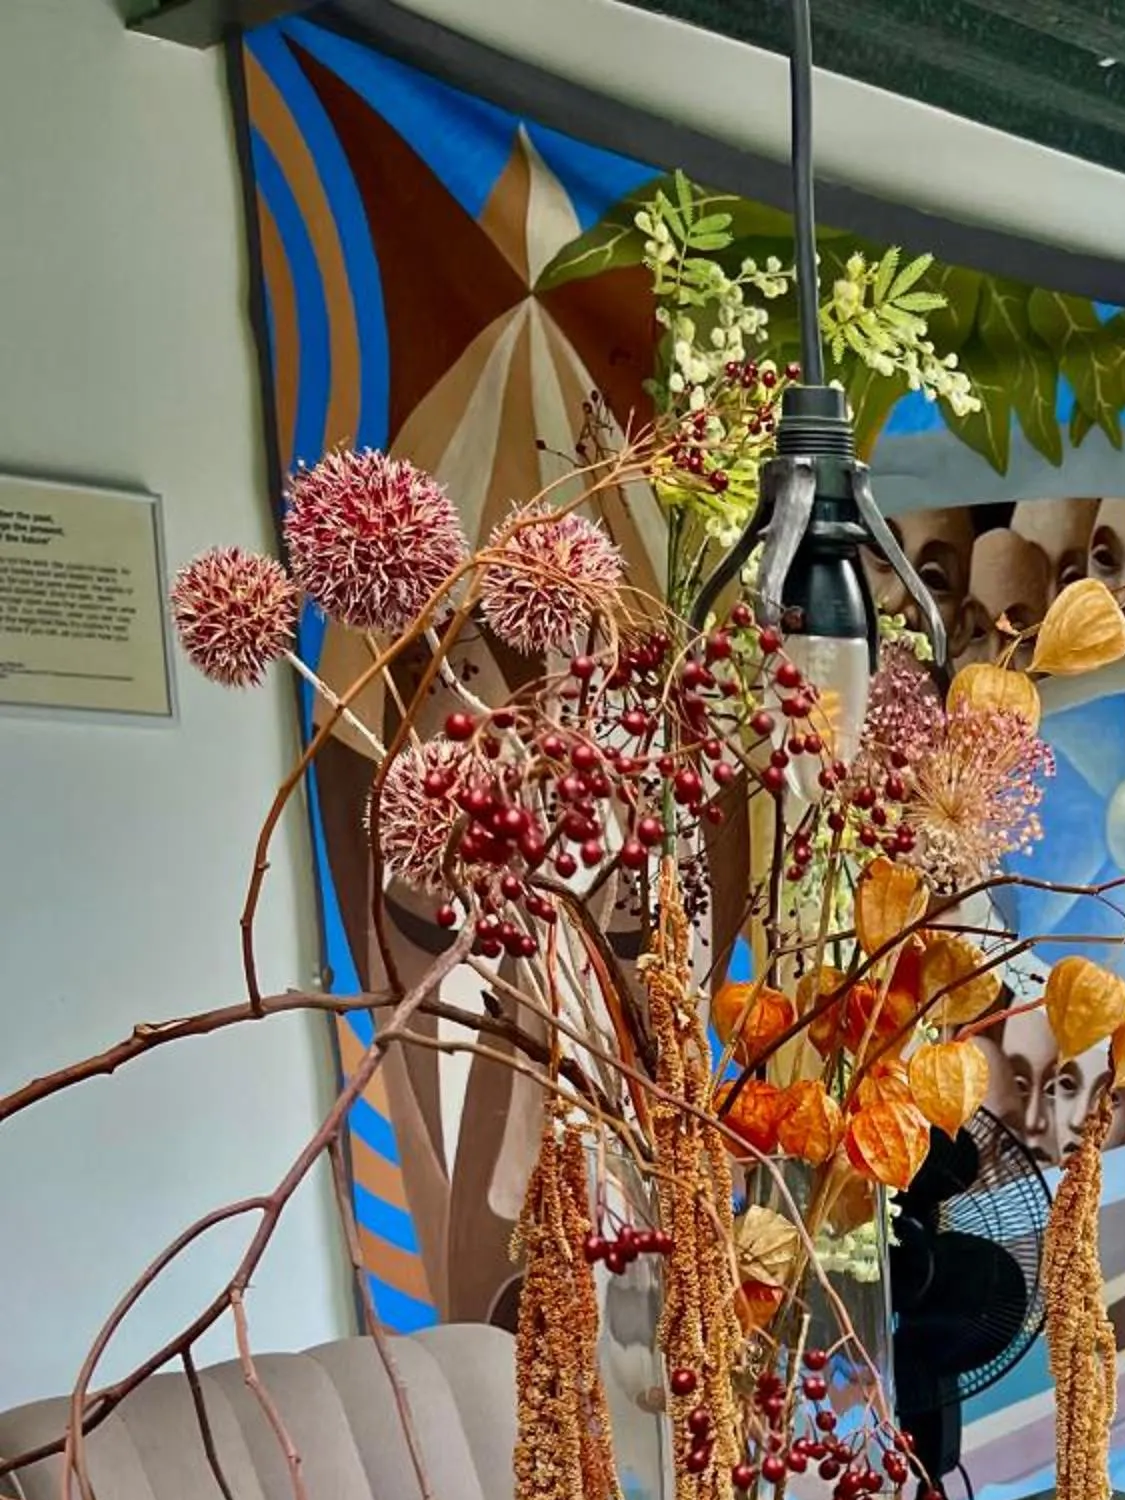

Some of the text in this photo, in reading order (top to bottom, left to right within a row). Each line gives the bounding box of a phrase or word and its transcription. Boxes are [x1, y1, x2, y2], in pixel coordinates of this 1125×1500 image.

[16, 511, 30, 521] the
[13, 523, 27, 532] the
[5, 534, 19, 543] the
